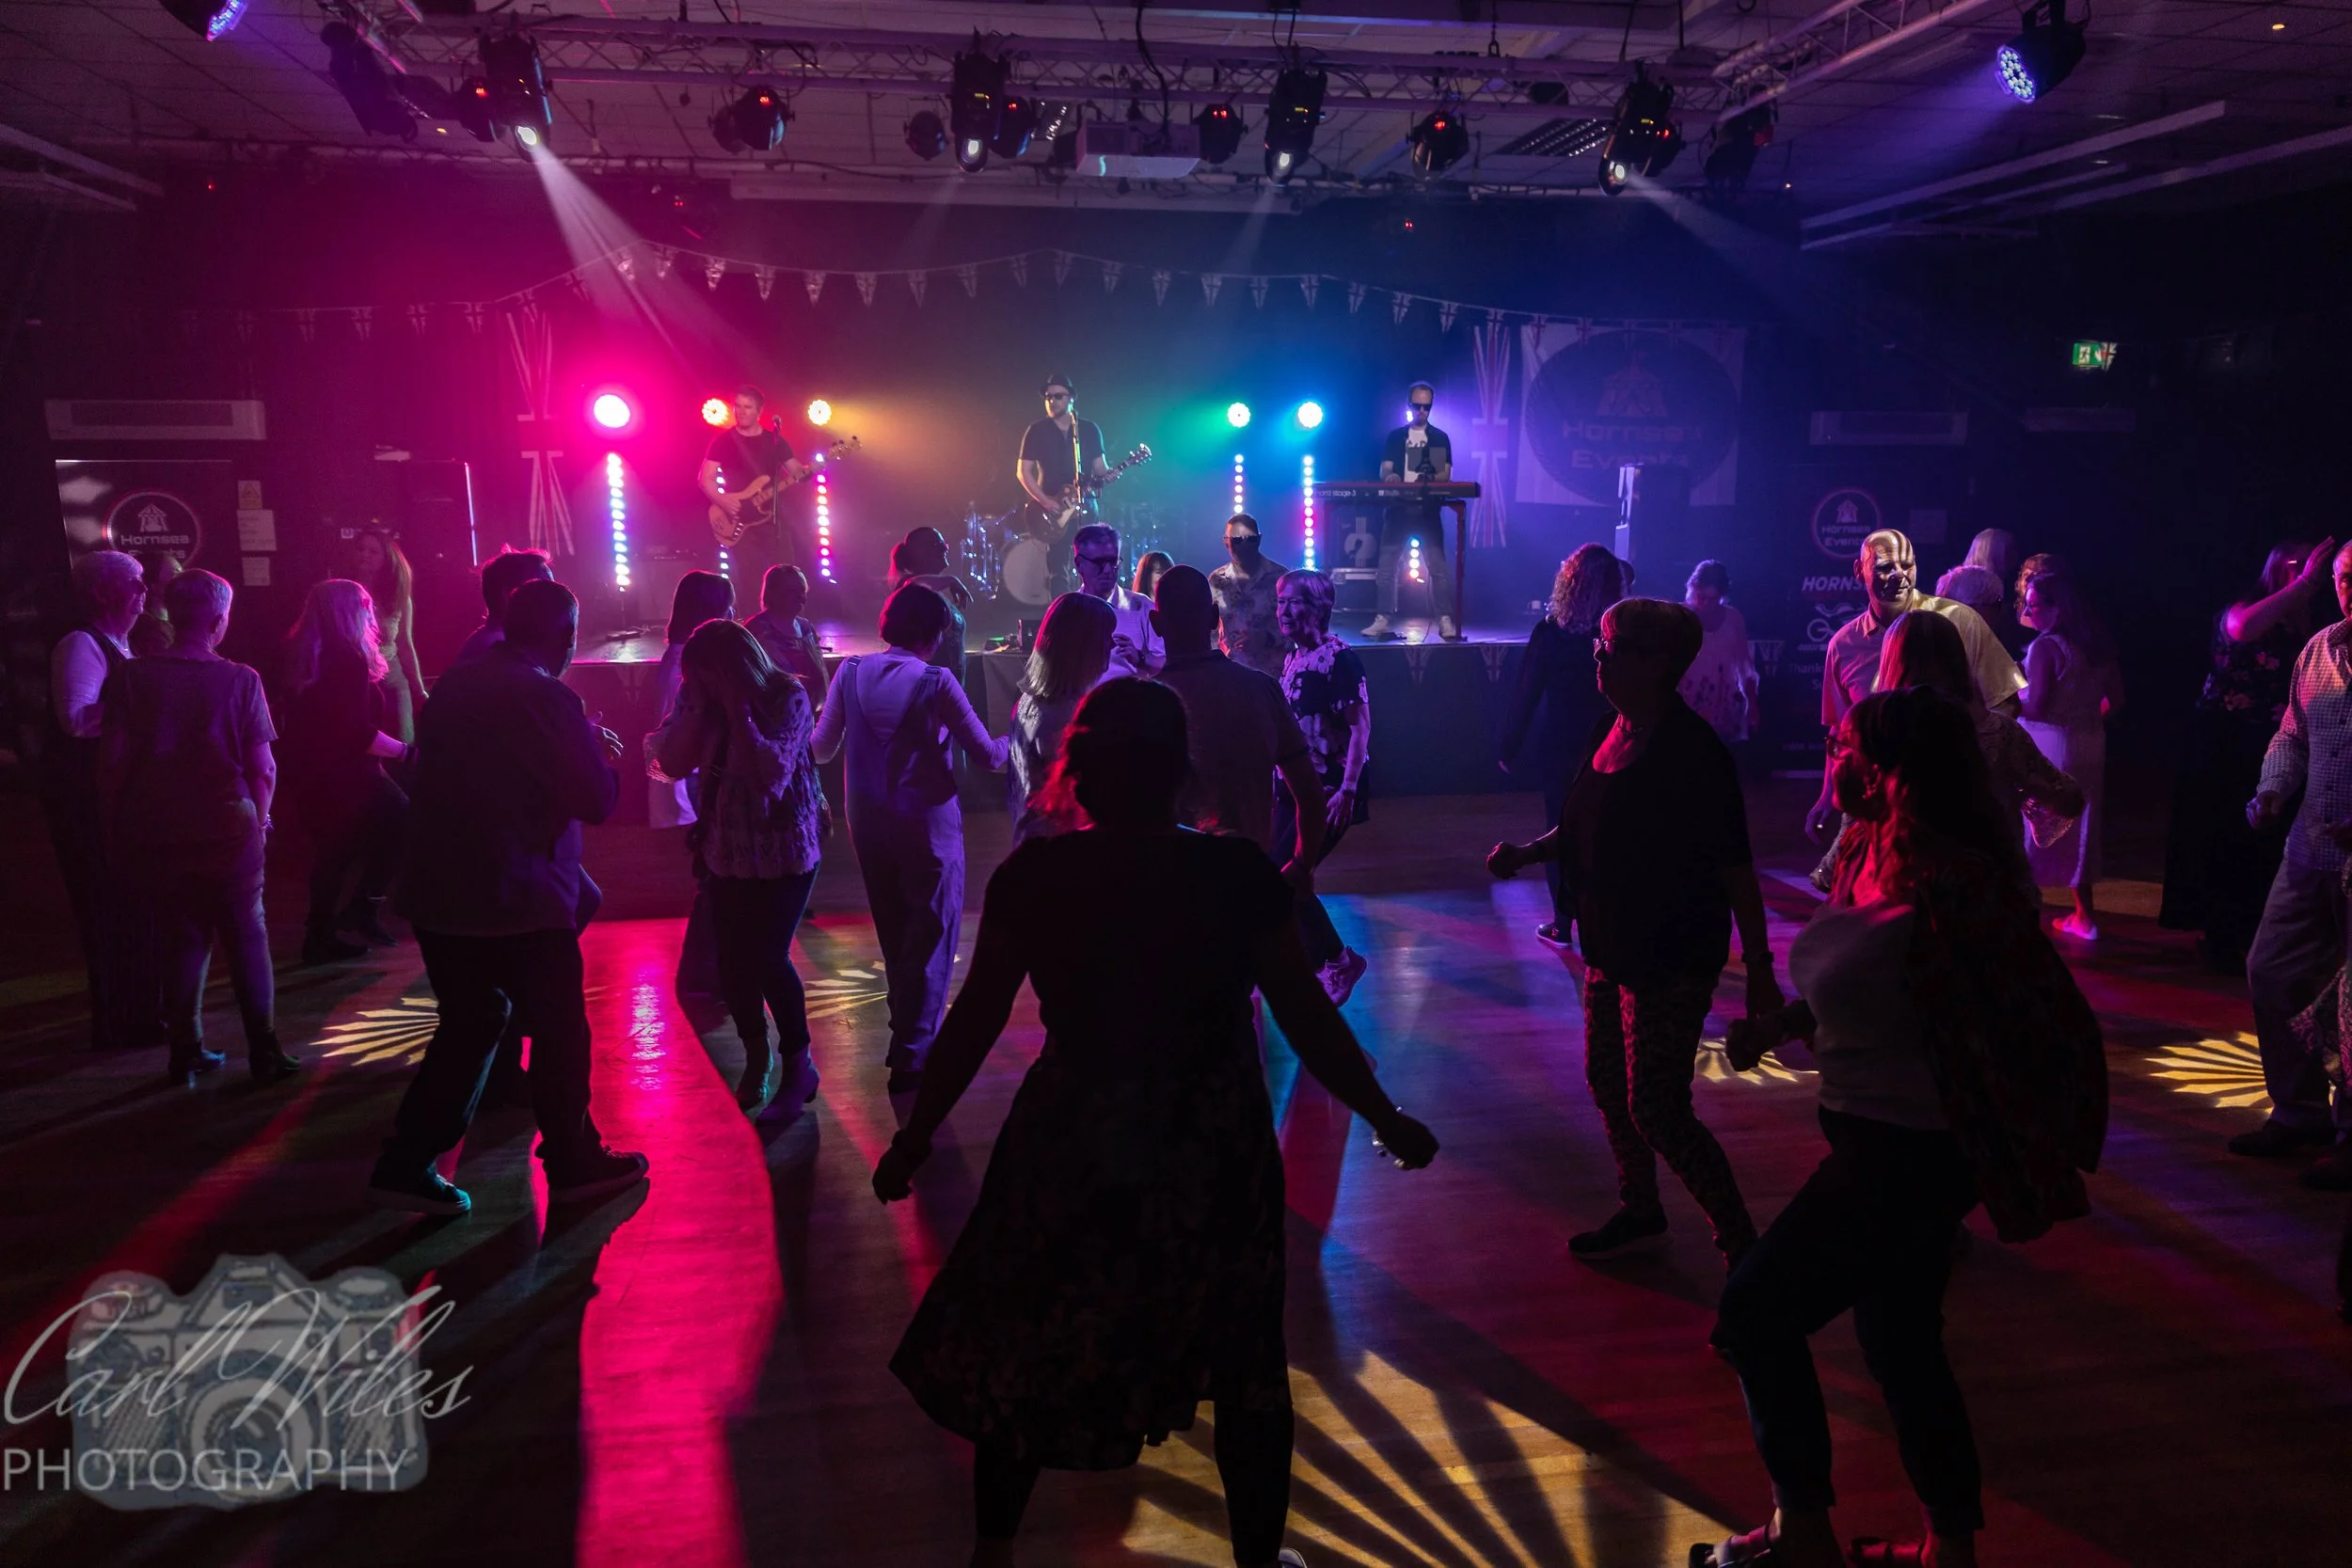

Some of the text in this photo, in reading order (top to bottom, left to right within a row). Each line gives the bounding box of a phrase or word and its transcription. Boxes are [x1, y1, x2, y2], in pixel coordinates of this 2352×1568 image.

[1562, 419, 1703, 443] Hornsea
[1821, 525, 1870, 534] Hornsea
[120, 533, 190, 546] Hornsea
[1802, 576, 1867, 592] HORNS
